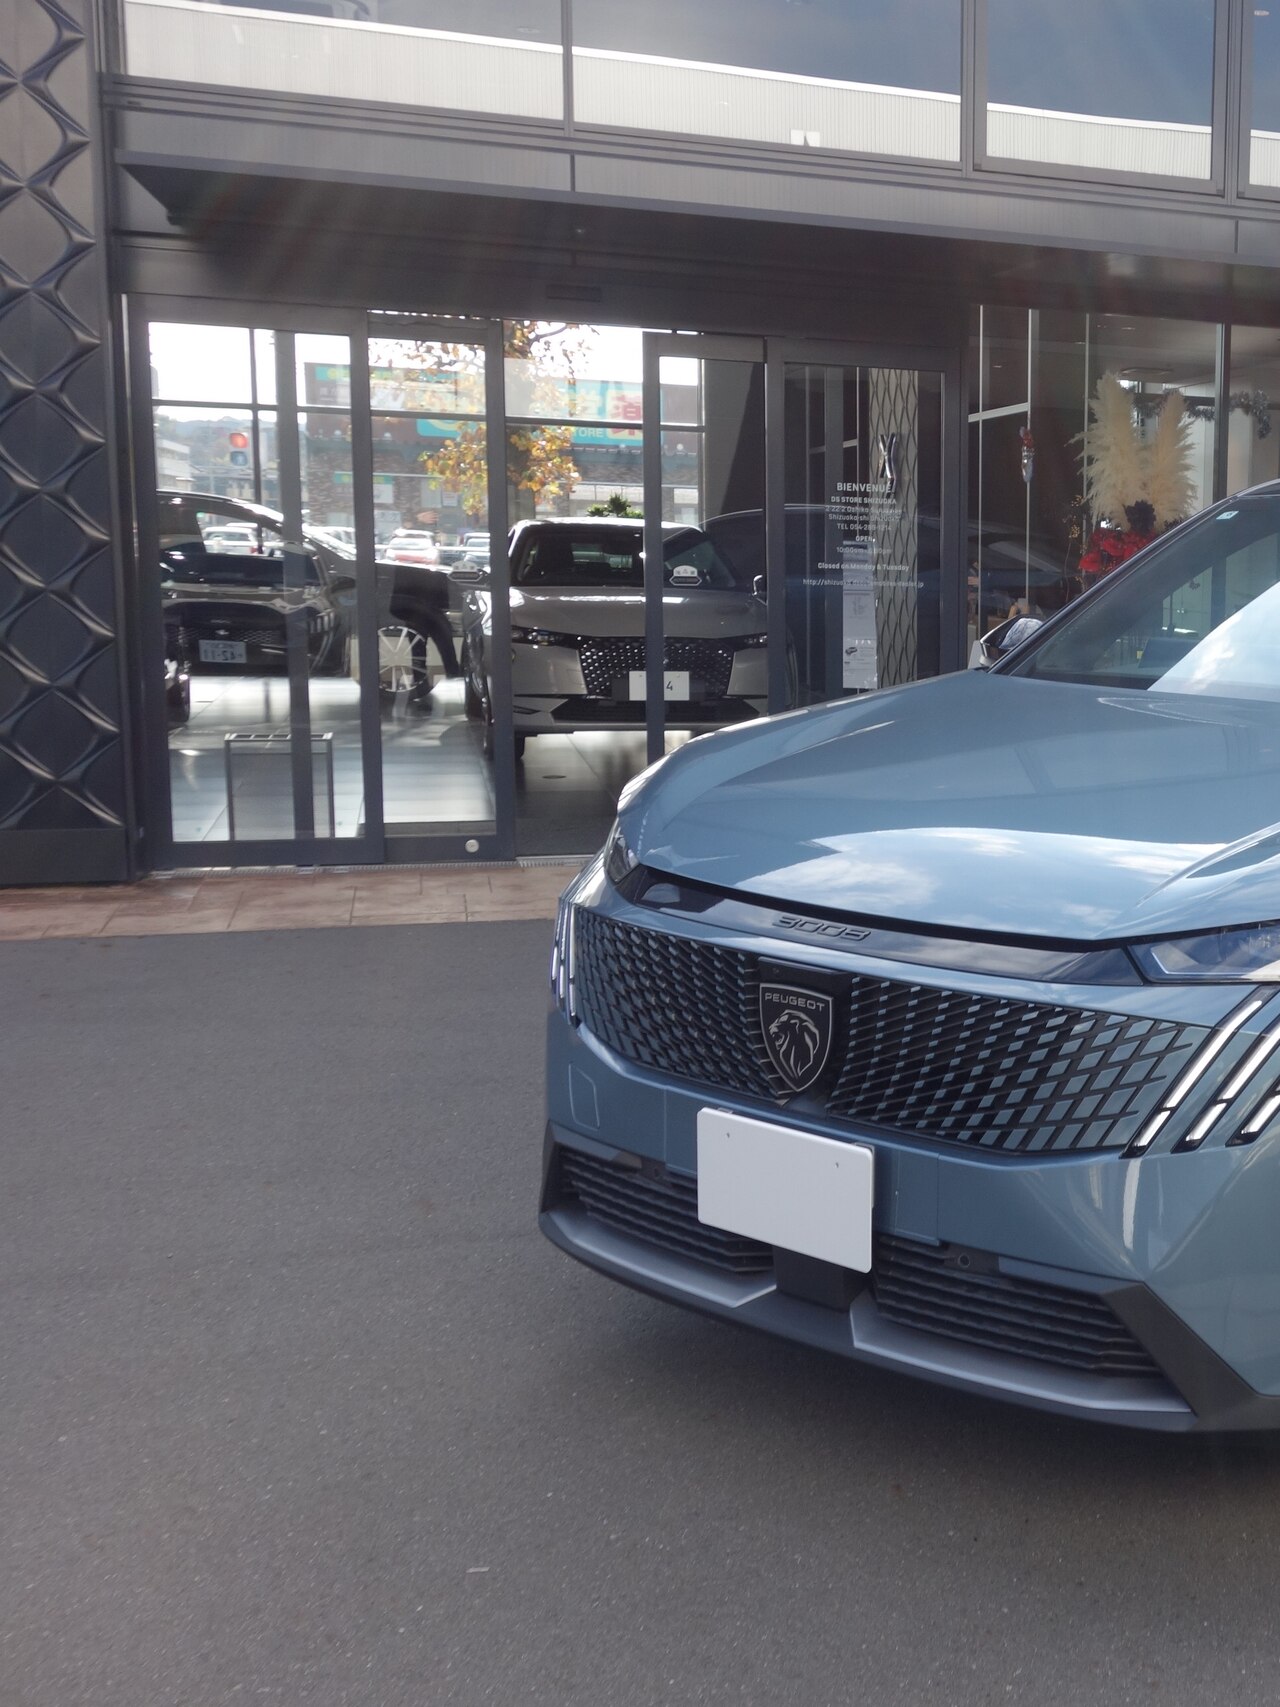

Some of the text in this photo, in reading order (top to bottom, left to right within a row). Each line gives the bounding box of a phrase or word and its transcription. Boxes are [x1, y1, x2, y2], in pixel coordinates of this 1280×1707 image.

[836, 482, 892, 493] BIENVENUE
[841, 496, 862, 504] STORE
[863, 497, 897, 505] SHIZUOKA
[817, 562, 840, 570] Closed
[882, 564, 910, 572] Tuesday
[772, 915, 872, 942] 3008
[764, 992, 825, 1012] PEUGEOT
